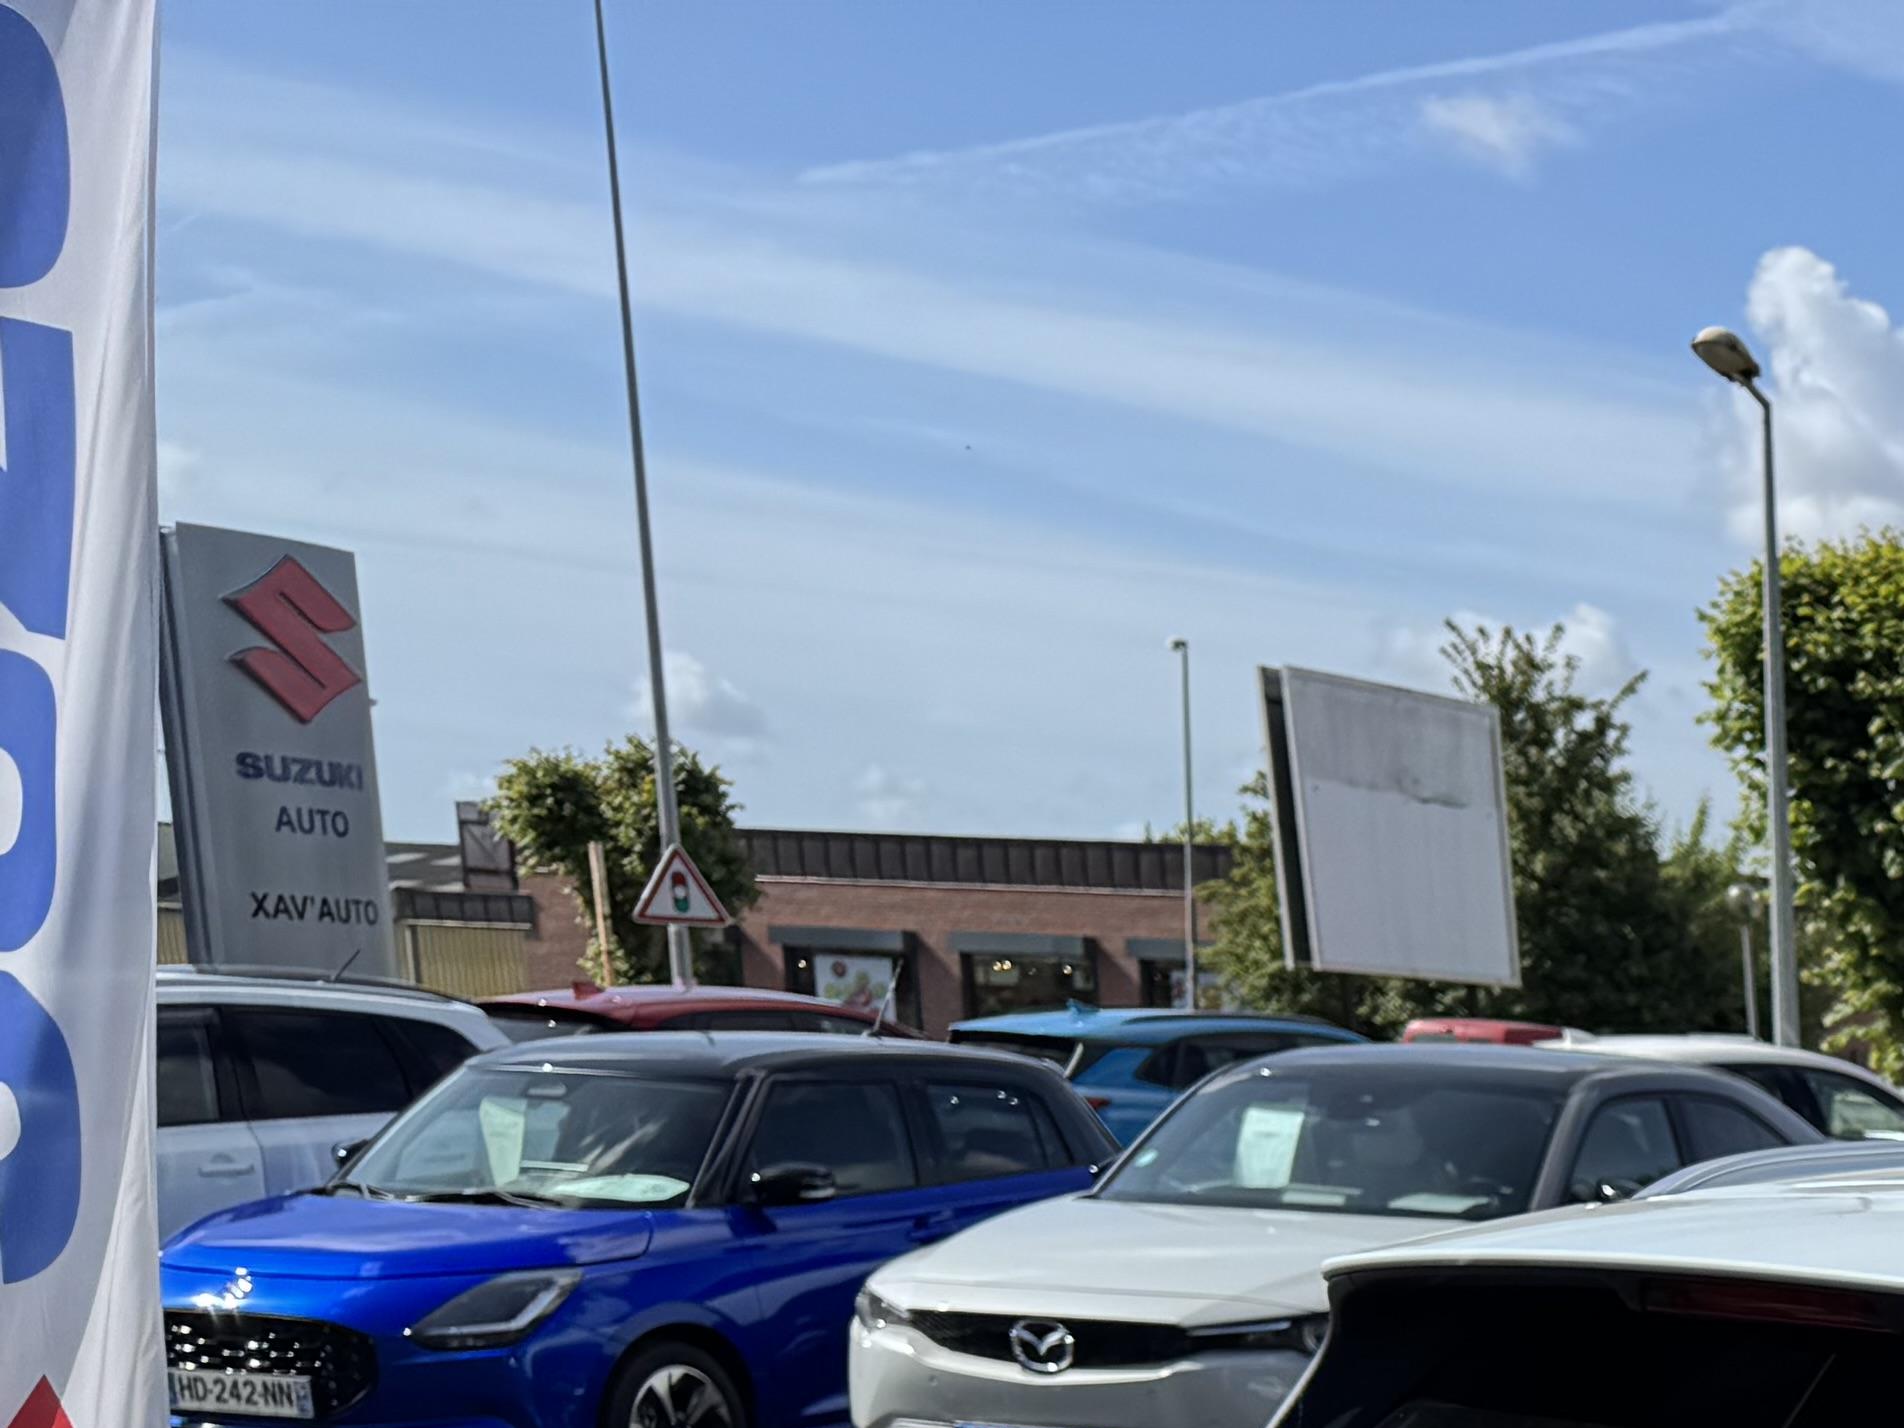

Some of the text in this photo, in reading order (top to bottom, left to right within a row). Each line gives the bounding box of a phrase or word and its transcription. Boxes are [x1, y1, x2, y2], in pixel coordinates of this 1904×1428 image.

[235, 751, 364, 791] SUZUKI
[275, 805, 350, 838] AUTO
[250, 891, 379, 926] XAV'AUTO
[178, 1376, 294, 1408] HD-242-NN
